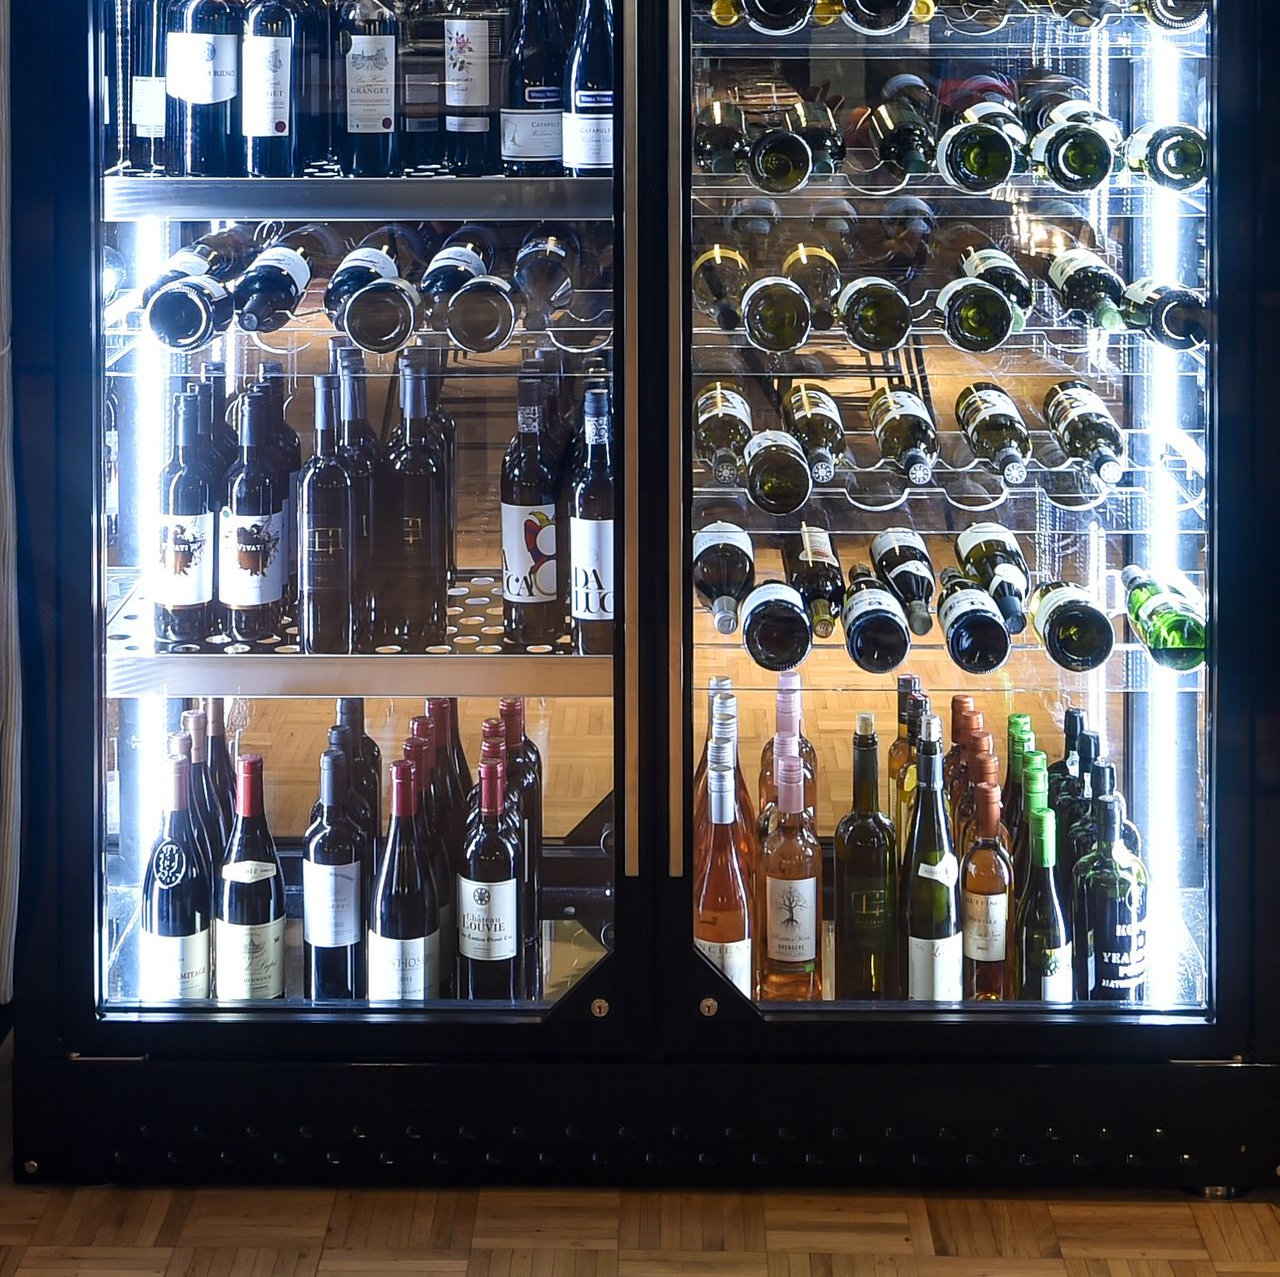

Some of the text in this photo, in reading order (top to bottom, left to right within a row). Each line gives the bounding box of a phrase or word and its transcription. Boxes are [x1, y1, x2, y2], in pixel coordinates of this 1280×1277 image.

[350, 87, 390, 95] GRANGET
[574, 590, 614, 614] LUC
[462, 913, 506, 932] LOUVIE
[466, 912, 501, 923] Château
